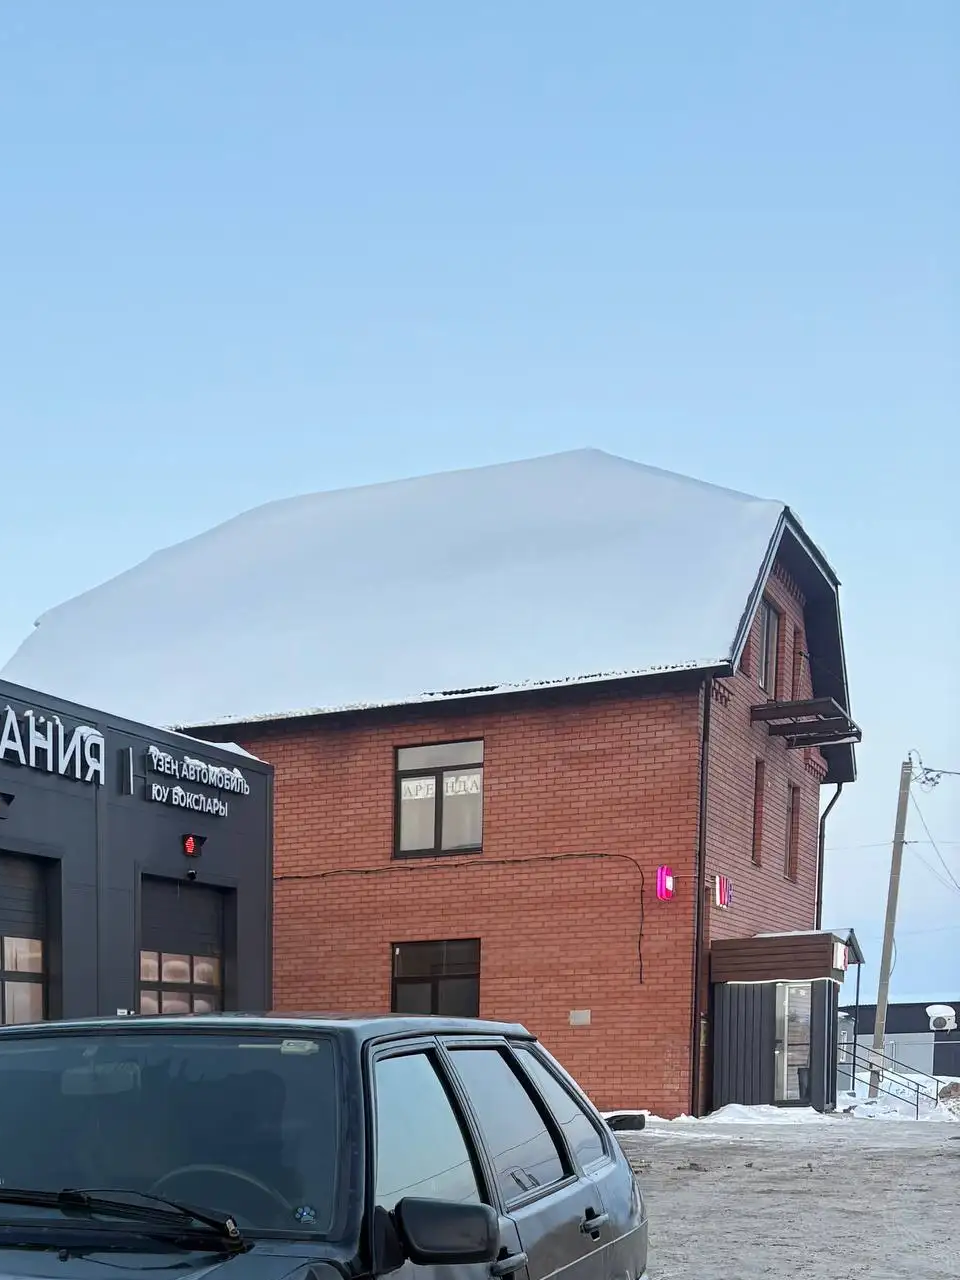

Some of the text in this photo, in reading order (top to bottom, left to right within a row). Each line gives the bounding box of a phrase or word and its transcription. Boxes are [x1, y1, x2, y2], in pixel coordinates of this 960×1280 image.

[181, 757, 250, 795] АВТОМОБИЛЬ
[152, 783, 228, 817] ЮУ БОКСЛАРЫ
